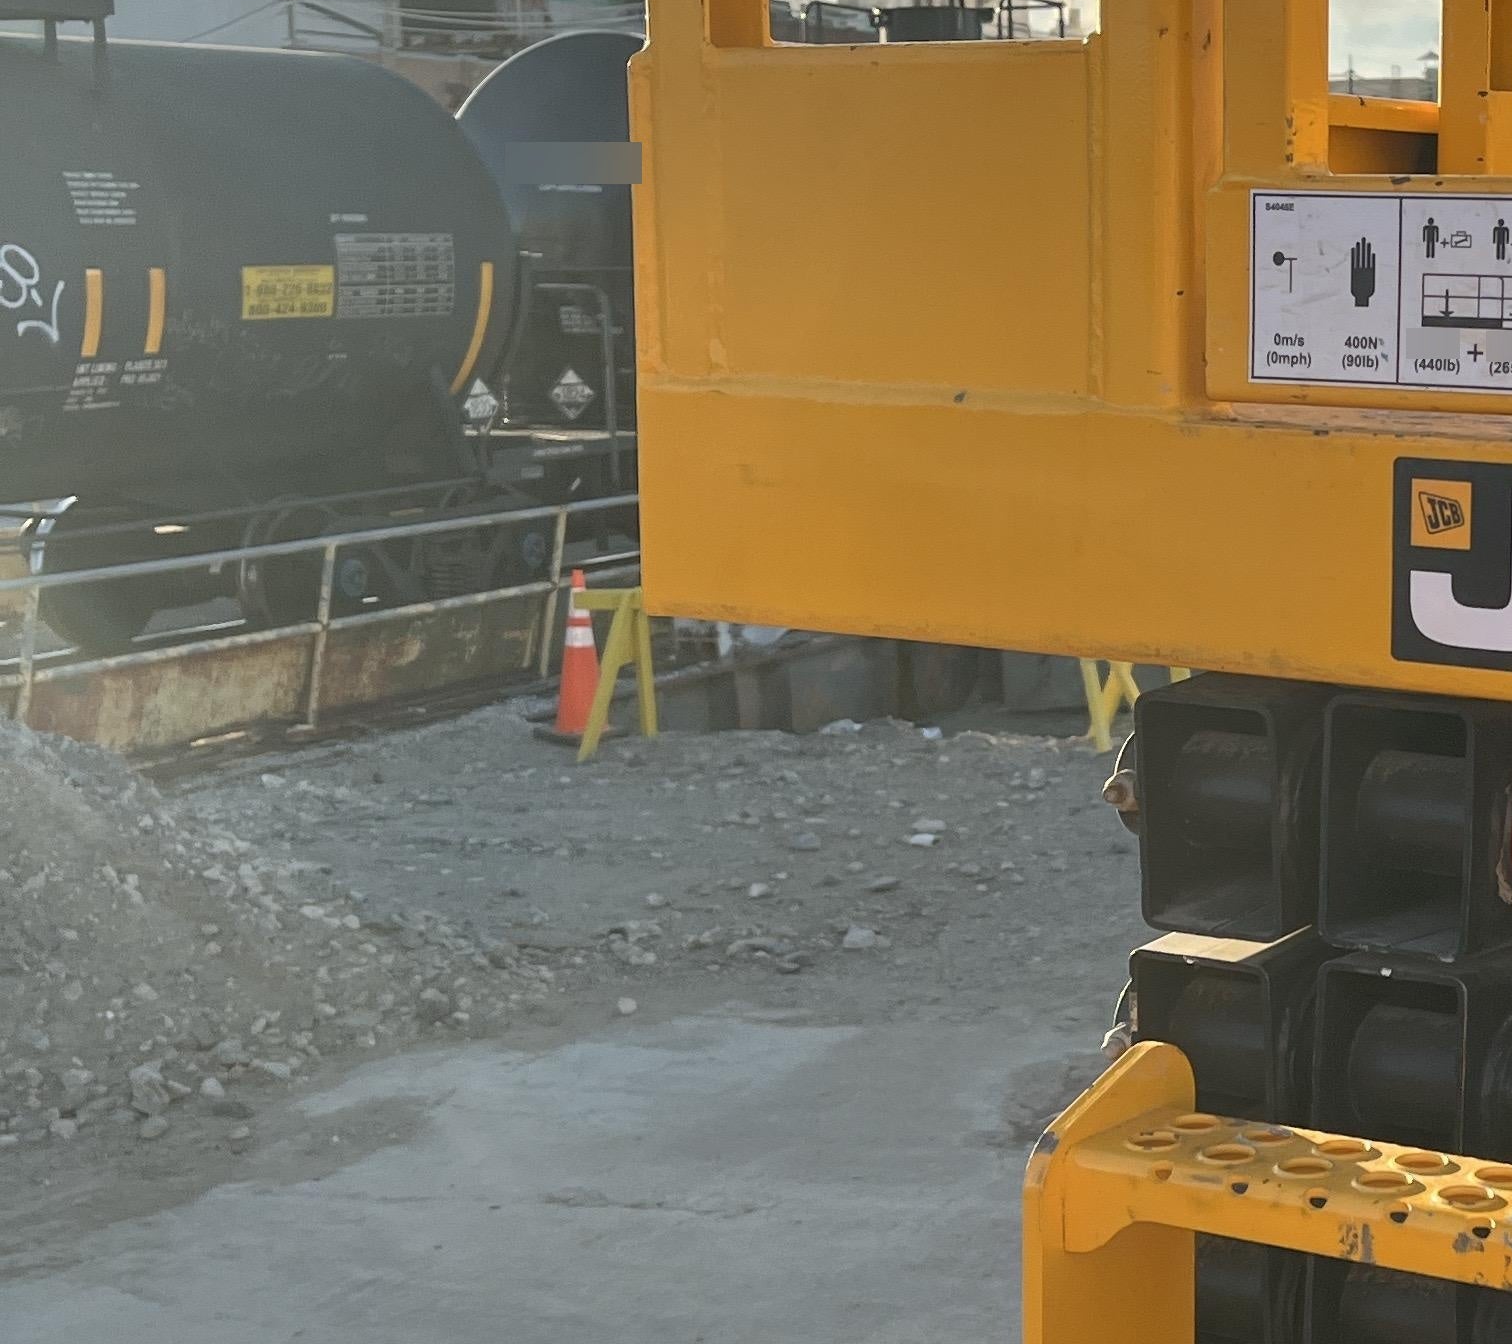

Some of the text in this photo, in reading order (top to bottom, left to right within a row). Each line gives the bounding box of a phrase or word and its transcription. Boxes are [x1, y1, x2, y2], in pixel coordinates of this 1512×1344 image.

[1273, 332, 1305, 347] 0m/s
[1344, 335, 1378, 350] 400N
[1266, 351, 1312, 369] (0mph)
[1341, 354, 1379, 372] (90lb)
[1414, 358, 1460, 375] (440lb)
[1426, 496, 1462, 530] JCB
